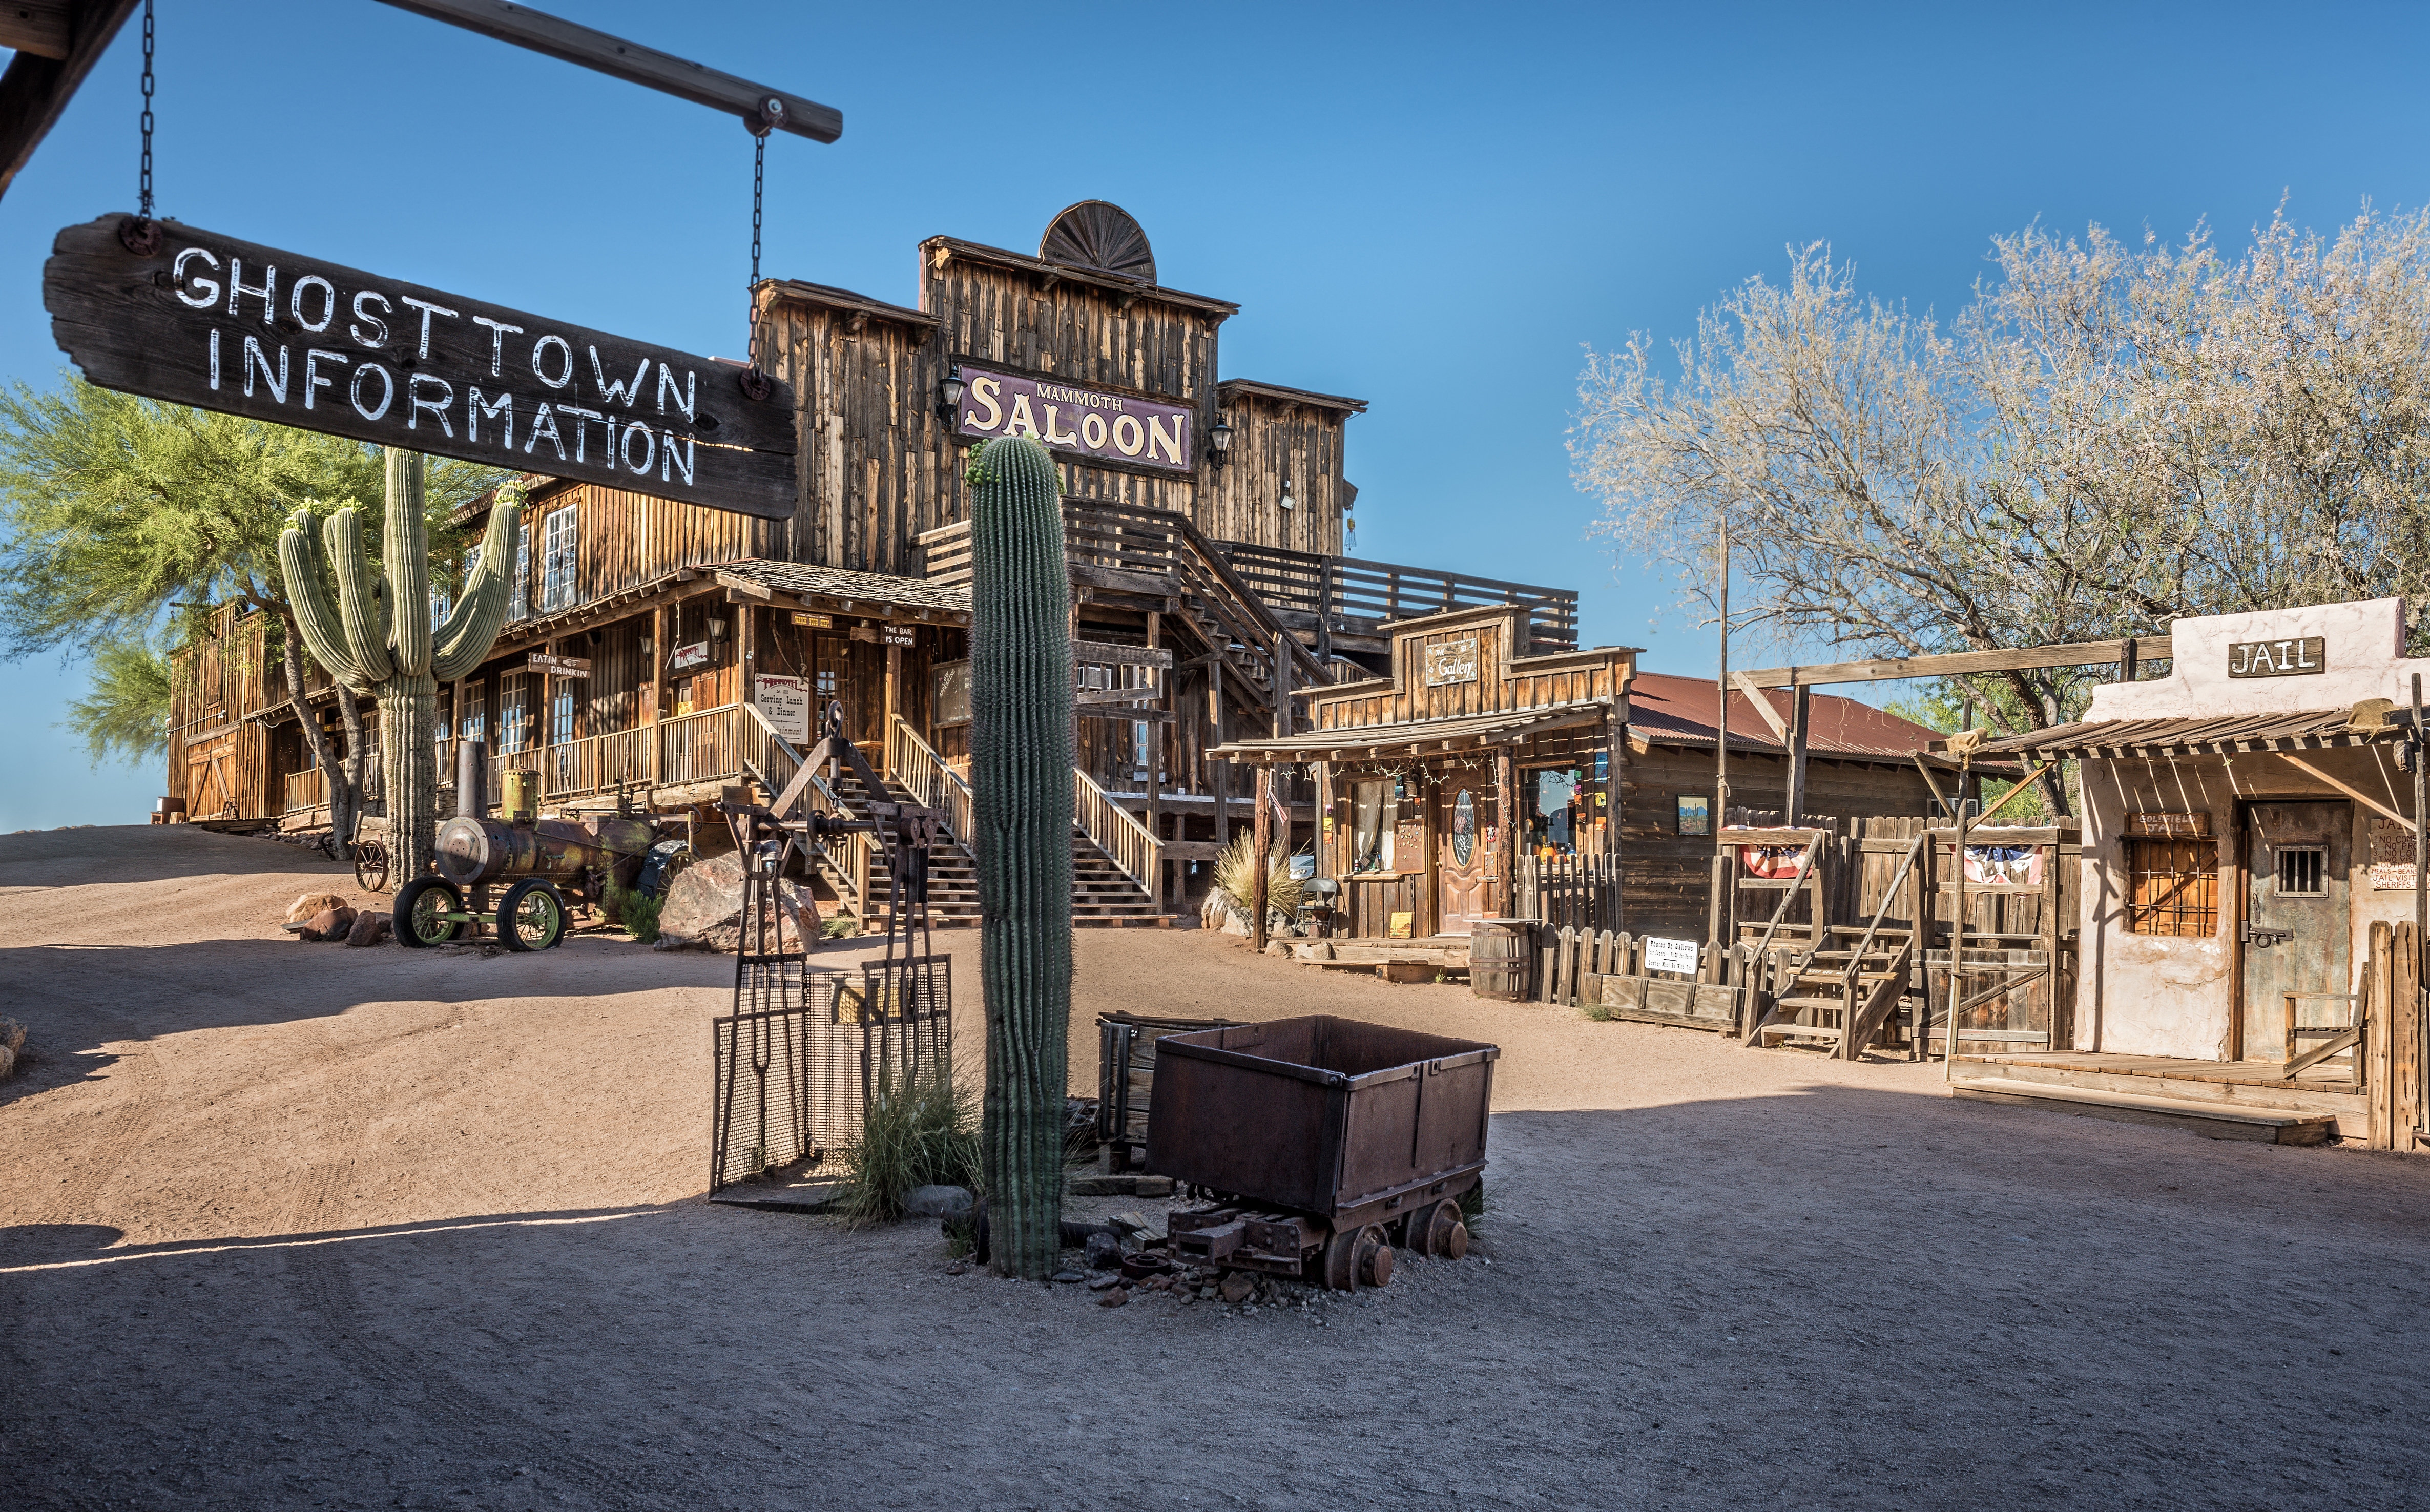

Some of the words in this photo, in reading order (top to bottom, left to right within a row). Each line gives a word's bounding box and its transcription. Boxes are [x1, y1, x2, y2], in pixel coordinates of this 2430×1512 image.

[473, 316, 697, 424] TOWN
[1036, 382, 1123, 412] MAMMOTH
[210, 328, 696, 487] INFORMATION
[965, 376, 1185, 466] SALOON
[895, 637, 912, 645] OPEN
[1436, 648, 1445, 656] THE
[2231, 639, 2316, 674] JAIL
[533, 654, 557, 665] EATIN
[551, 666, 587, 677] DRINKIN
[1439, 658, 1473, 678] Gallery
[939, 668, 956, 698] APPEARING
[761, 694, 782, 706] Serving
[786, 696, 803, 705] Lunch
[769, 707, 773, 715] &
[777, 707, 795, 716] Dinner
[2147, 824, 2183, 832] JAIL
[1650, 940, 1665, 948] Photos
[1675, 943, 1693, 952] Gallows
